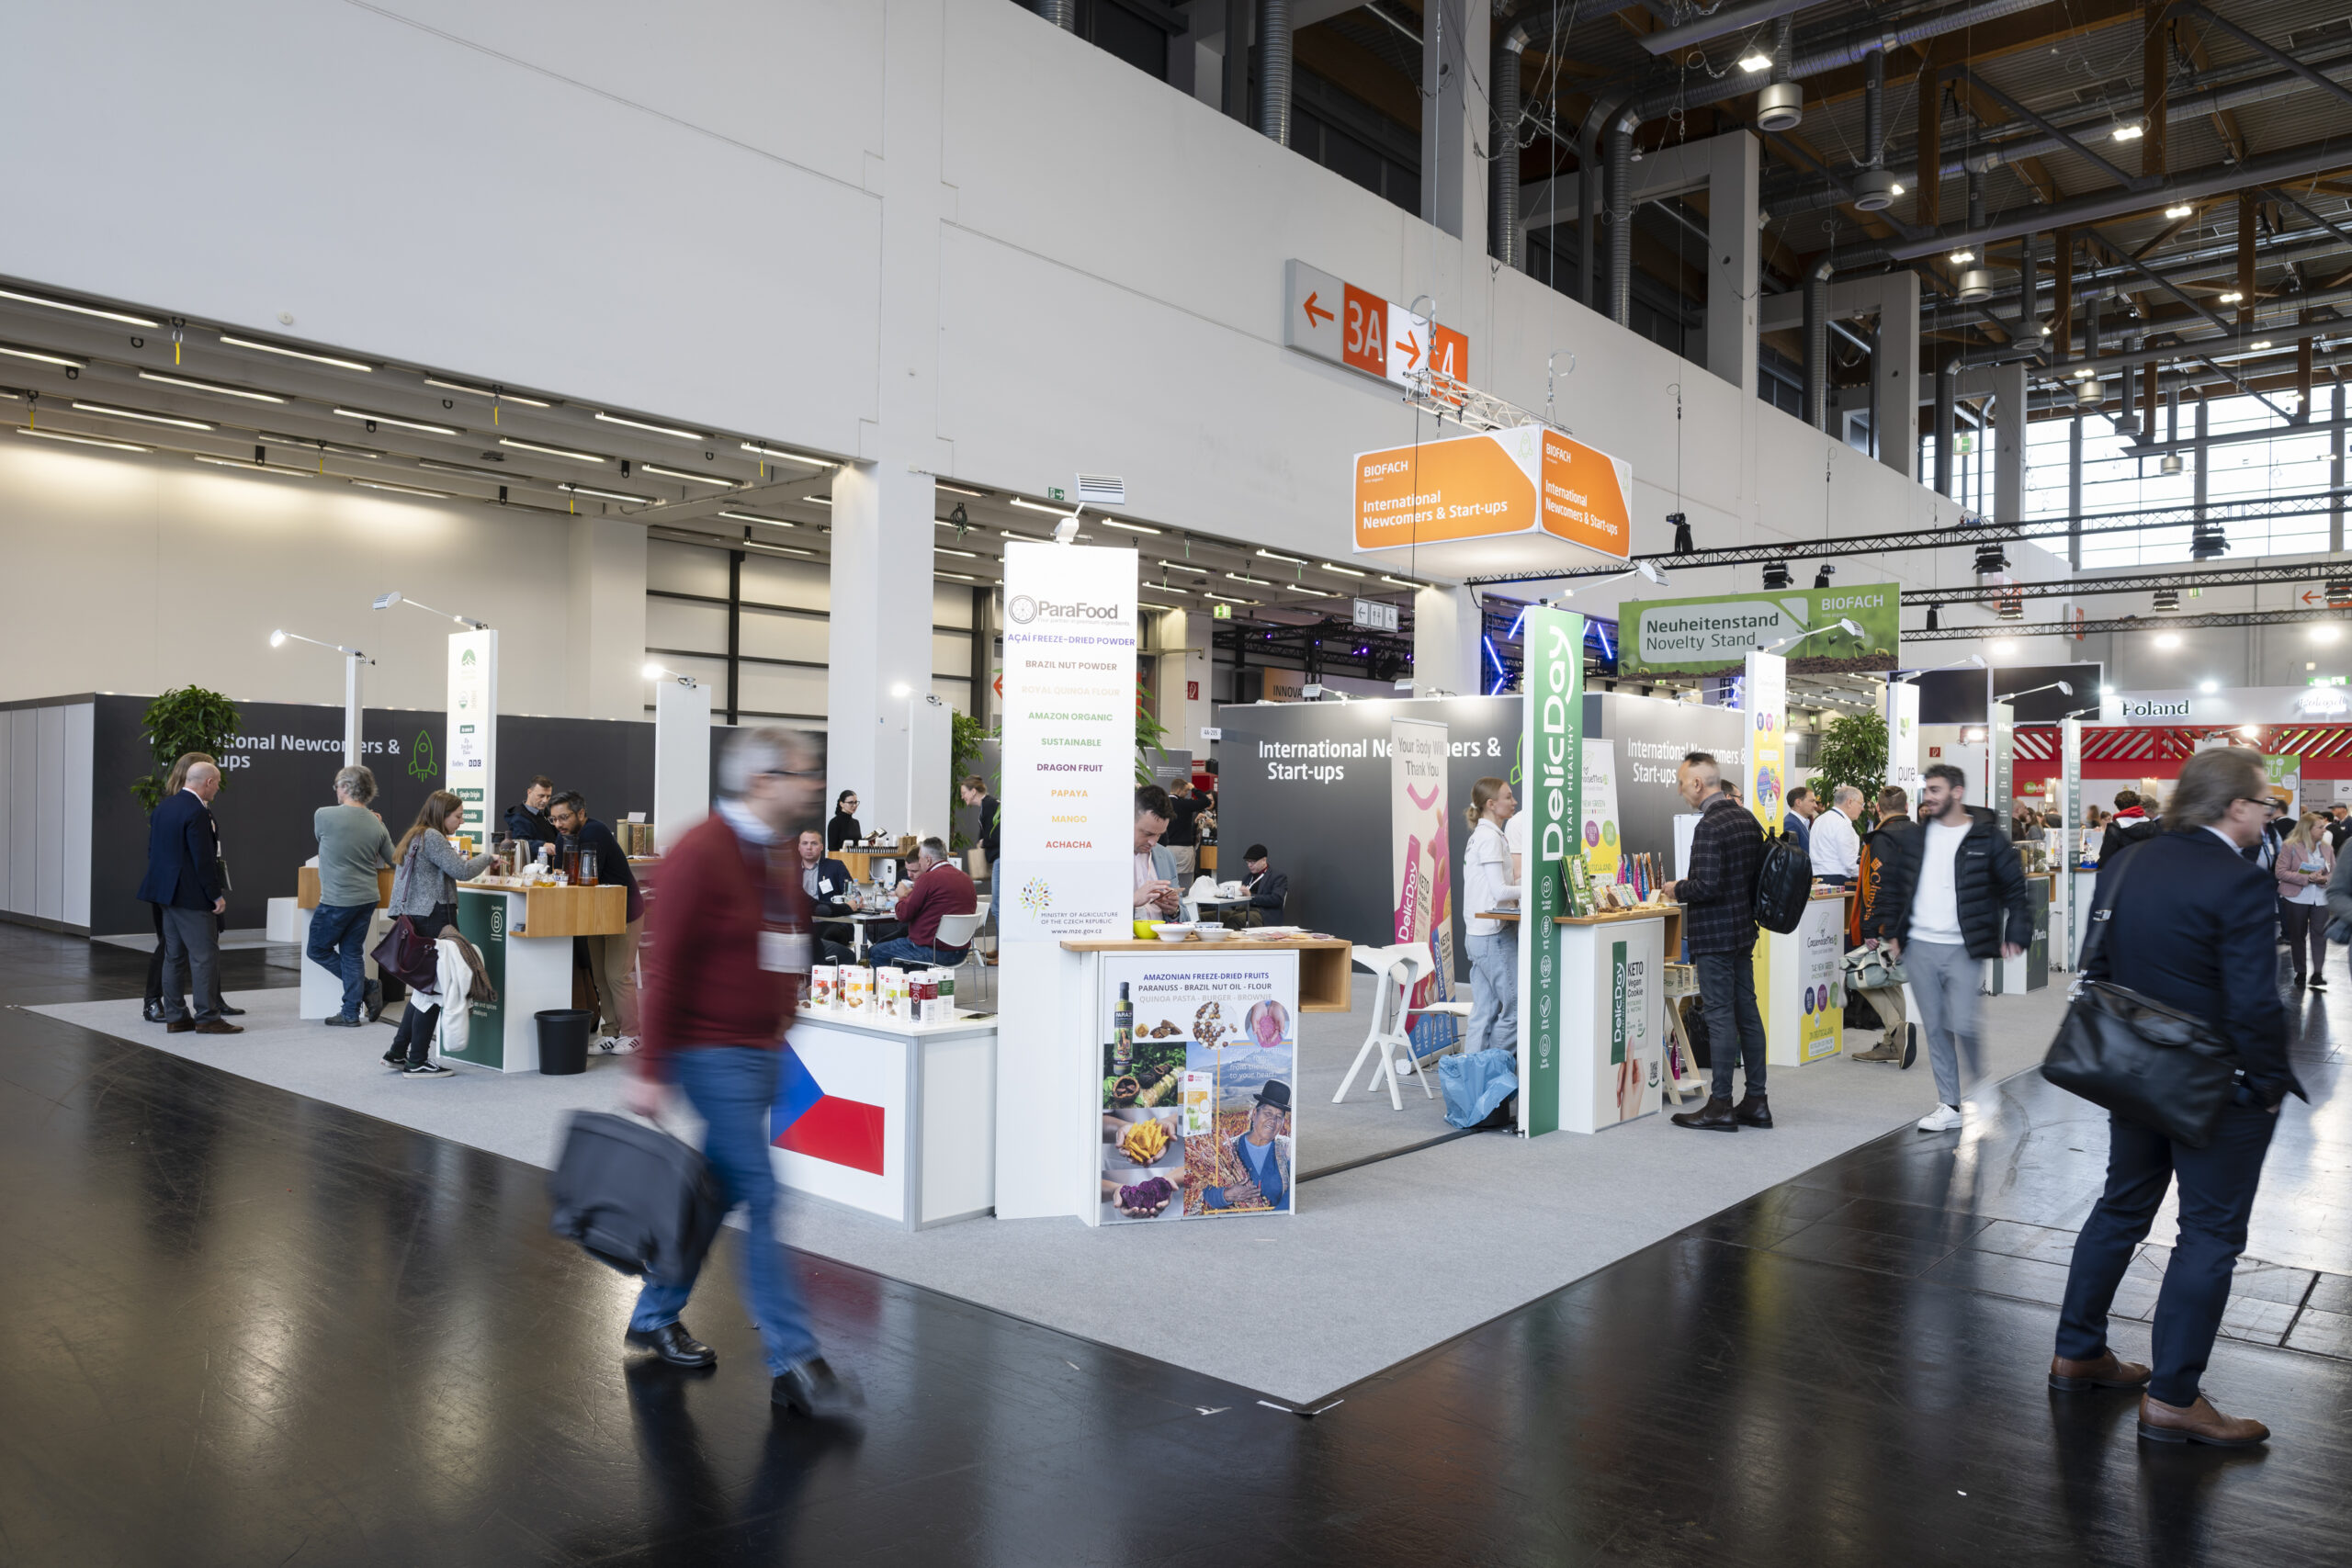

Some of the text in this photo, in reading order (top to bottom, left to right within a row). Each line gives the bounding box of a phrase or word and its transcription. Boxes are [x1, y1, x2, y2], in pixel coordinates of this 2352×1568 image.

[1348, 300, 1384, 362] 3A
[1546, 443, 1571, 464] BIOFACH
[1363, 460, 1408, 478] BIOFACH
[1363, 490, 1441, 513] International
[1545, 479, 1588, 507] International
[1363, 501, 1508, 530] Newcomers & Start-ups
[1545, 497, 1618, 536] Newcomers & Start-ups
[1038, 600, 1118, 619] ParaFood
[1821, 594, 1884, 611] BIOFACH
[1646, 612, 1779, 634] Neuheitenstand
[1008, 632, 1136, 646] AÇAÍ FREEZE-DRIED POWDER
[1646, 632, 1756, 651] Novelty Stand
[1025, 660, 1117, 671] BRAZIL NUT POWDER
[1022, 686, 1120, 696] ROYAL QUINOA FLOUR
[1273, 685, 1304, 698] INNOVA
[1028, 712, 1114, 721] AMAZON ORGANIC
[280, 735, 383, 753] Newcoers
[388, 739, 401, 754] &
[1041, 738, 1102, 747] SUSTAINABLE
[1259, 739, 1367, 759] International
[1487, 737, 1501, 757] &
[1397, 737, 1444, 757] Your Body Will
[1542, 625, 1575, 862] DelicDay
[1627, 737, 1689, 761] International
[1036, 763, 1103, 773] DRAGON FRUIT
[1268, 761, 1344, 784] Start-ups
[1405, 761, 1440, 778] Thank You
[1634, 762, 1677, 788] Start-ups
[1898, 766, 1916, 785] pure
[1051, 789, 1089, 798] PAPAYA
[1051, 815, 1088, 823] MANGO
[1046, 840, 1092, 849] ACHACHA
[1397, 861, 1418, 942] DelicDay
[1627, 961, 1644, 977] KETO
[1138, 984, 1179, 992] PARANUSS
[1628, 978, 1642, 988] Vegan
[1139, 995, 1170, 1003] QUINOA
[1237, 993, 1272, 1001] BROWNIE
[1627, 988, 1644, 998] Cookie
[1614, 963, 1625, 1043] DelicDay
